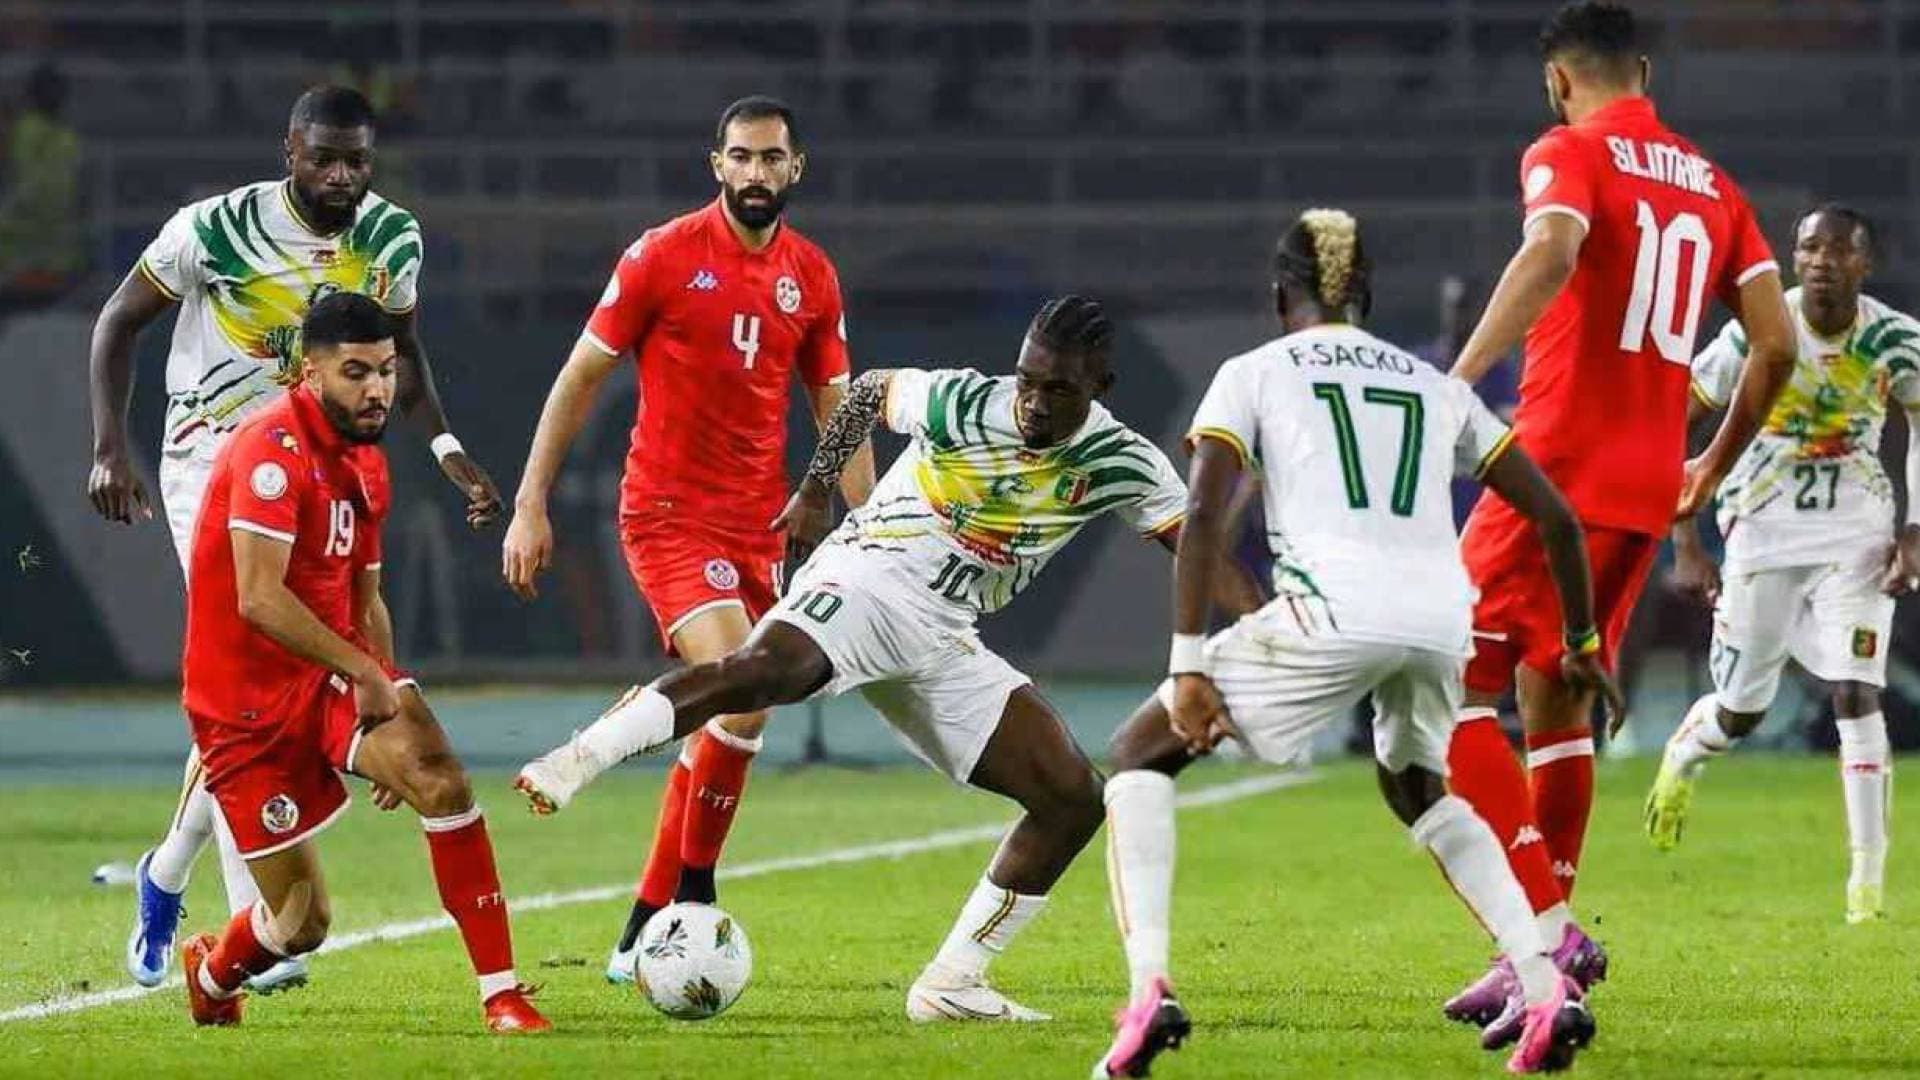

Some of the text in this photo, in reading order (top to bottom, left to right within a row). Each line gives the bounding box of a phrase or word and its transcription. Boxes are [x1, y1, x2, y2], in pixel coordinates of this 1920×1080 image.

[1619, 199, 1712, 366] 10
[732, 313, 760, 369] 4
[1312, 383, 1424, 517] 17
[1795, 465, 1840, 510] 27
[324, 499, 355, 556] 19
[788, 590, 843, 624] 10
